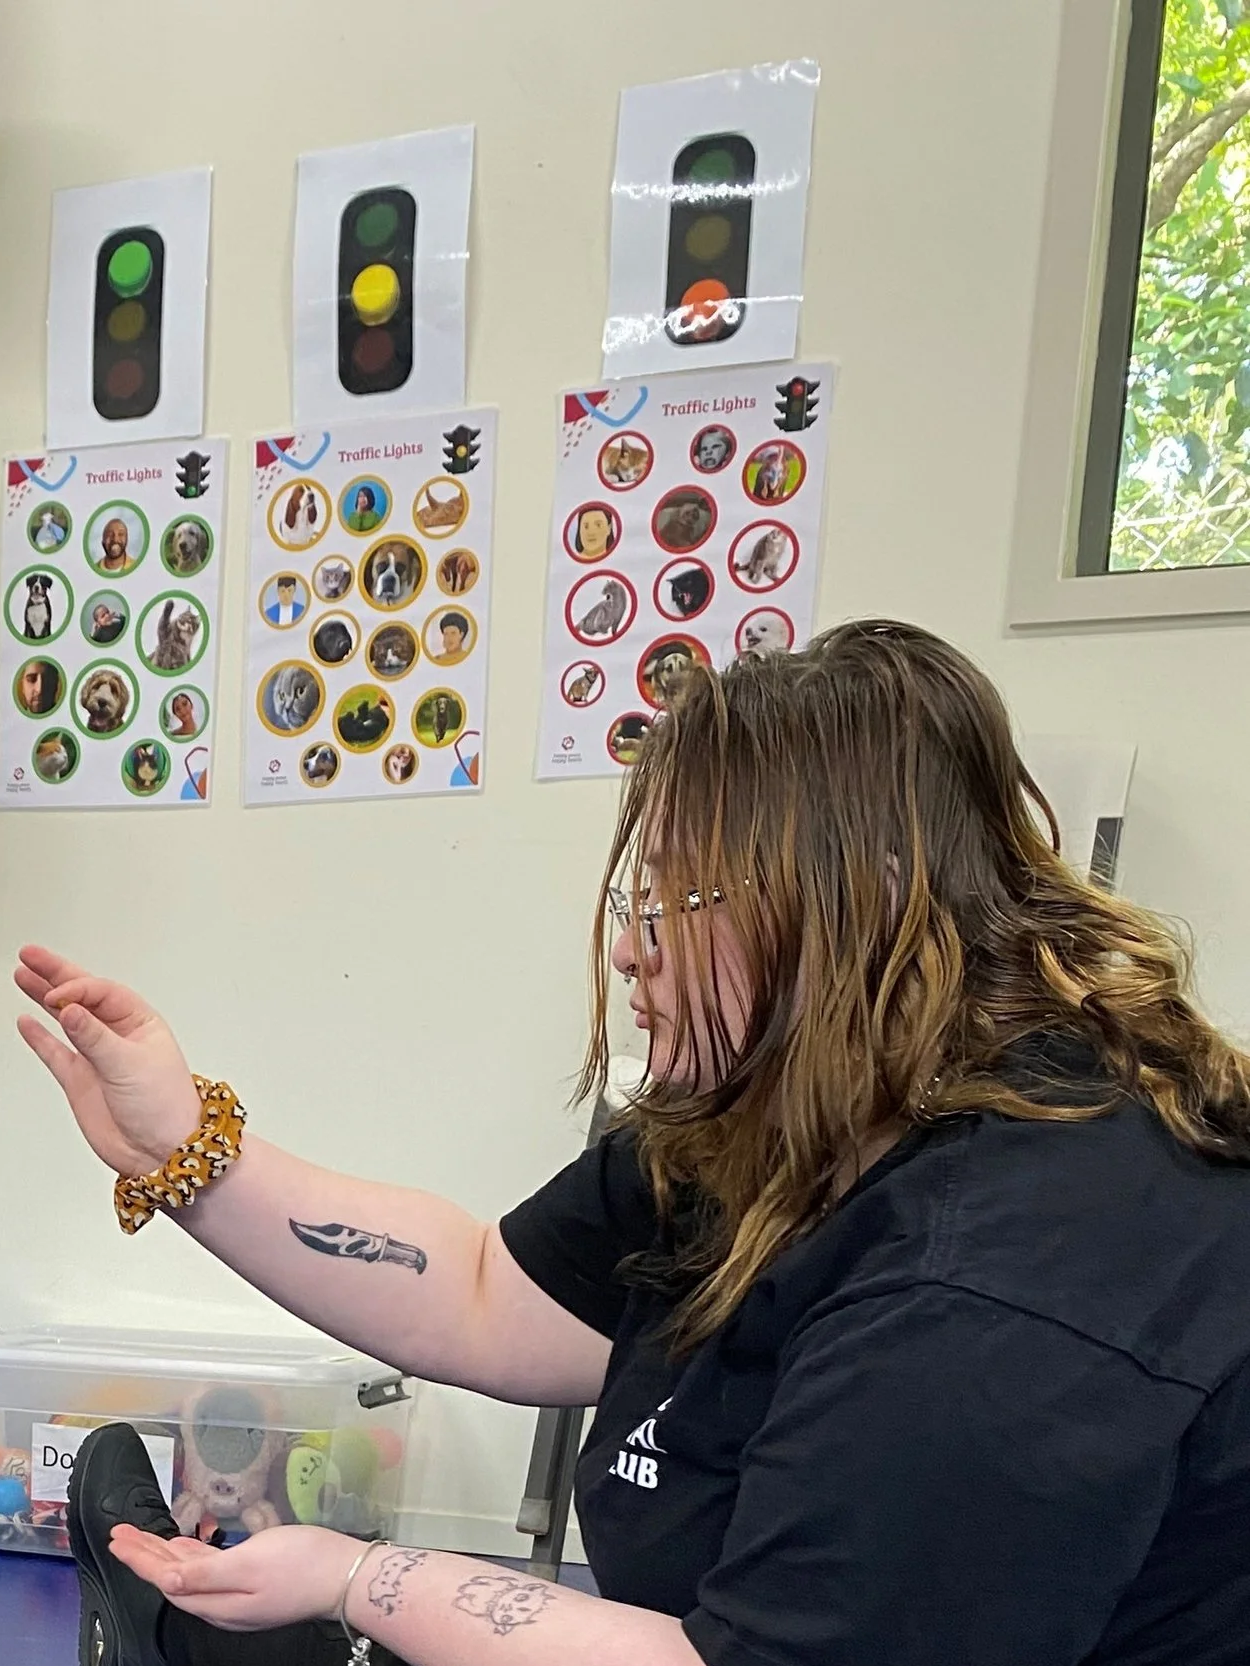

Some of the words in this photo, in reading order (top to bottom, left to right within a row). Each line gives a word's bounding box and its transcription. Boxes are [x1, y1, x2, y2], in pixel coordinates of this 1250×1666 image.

[662, 399, 709, 416] Traffic
[712, 396, 756, 414] Lights
[338, 446, 381, 462] Traffic
[384, 442, 423, 459] Lights
[86, 469, 124, 484] Traffic
[127, 467, 162, 483] Lights
